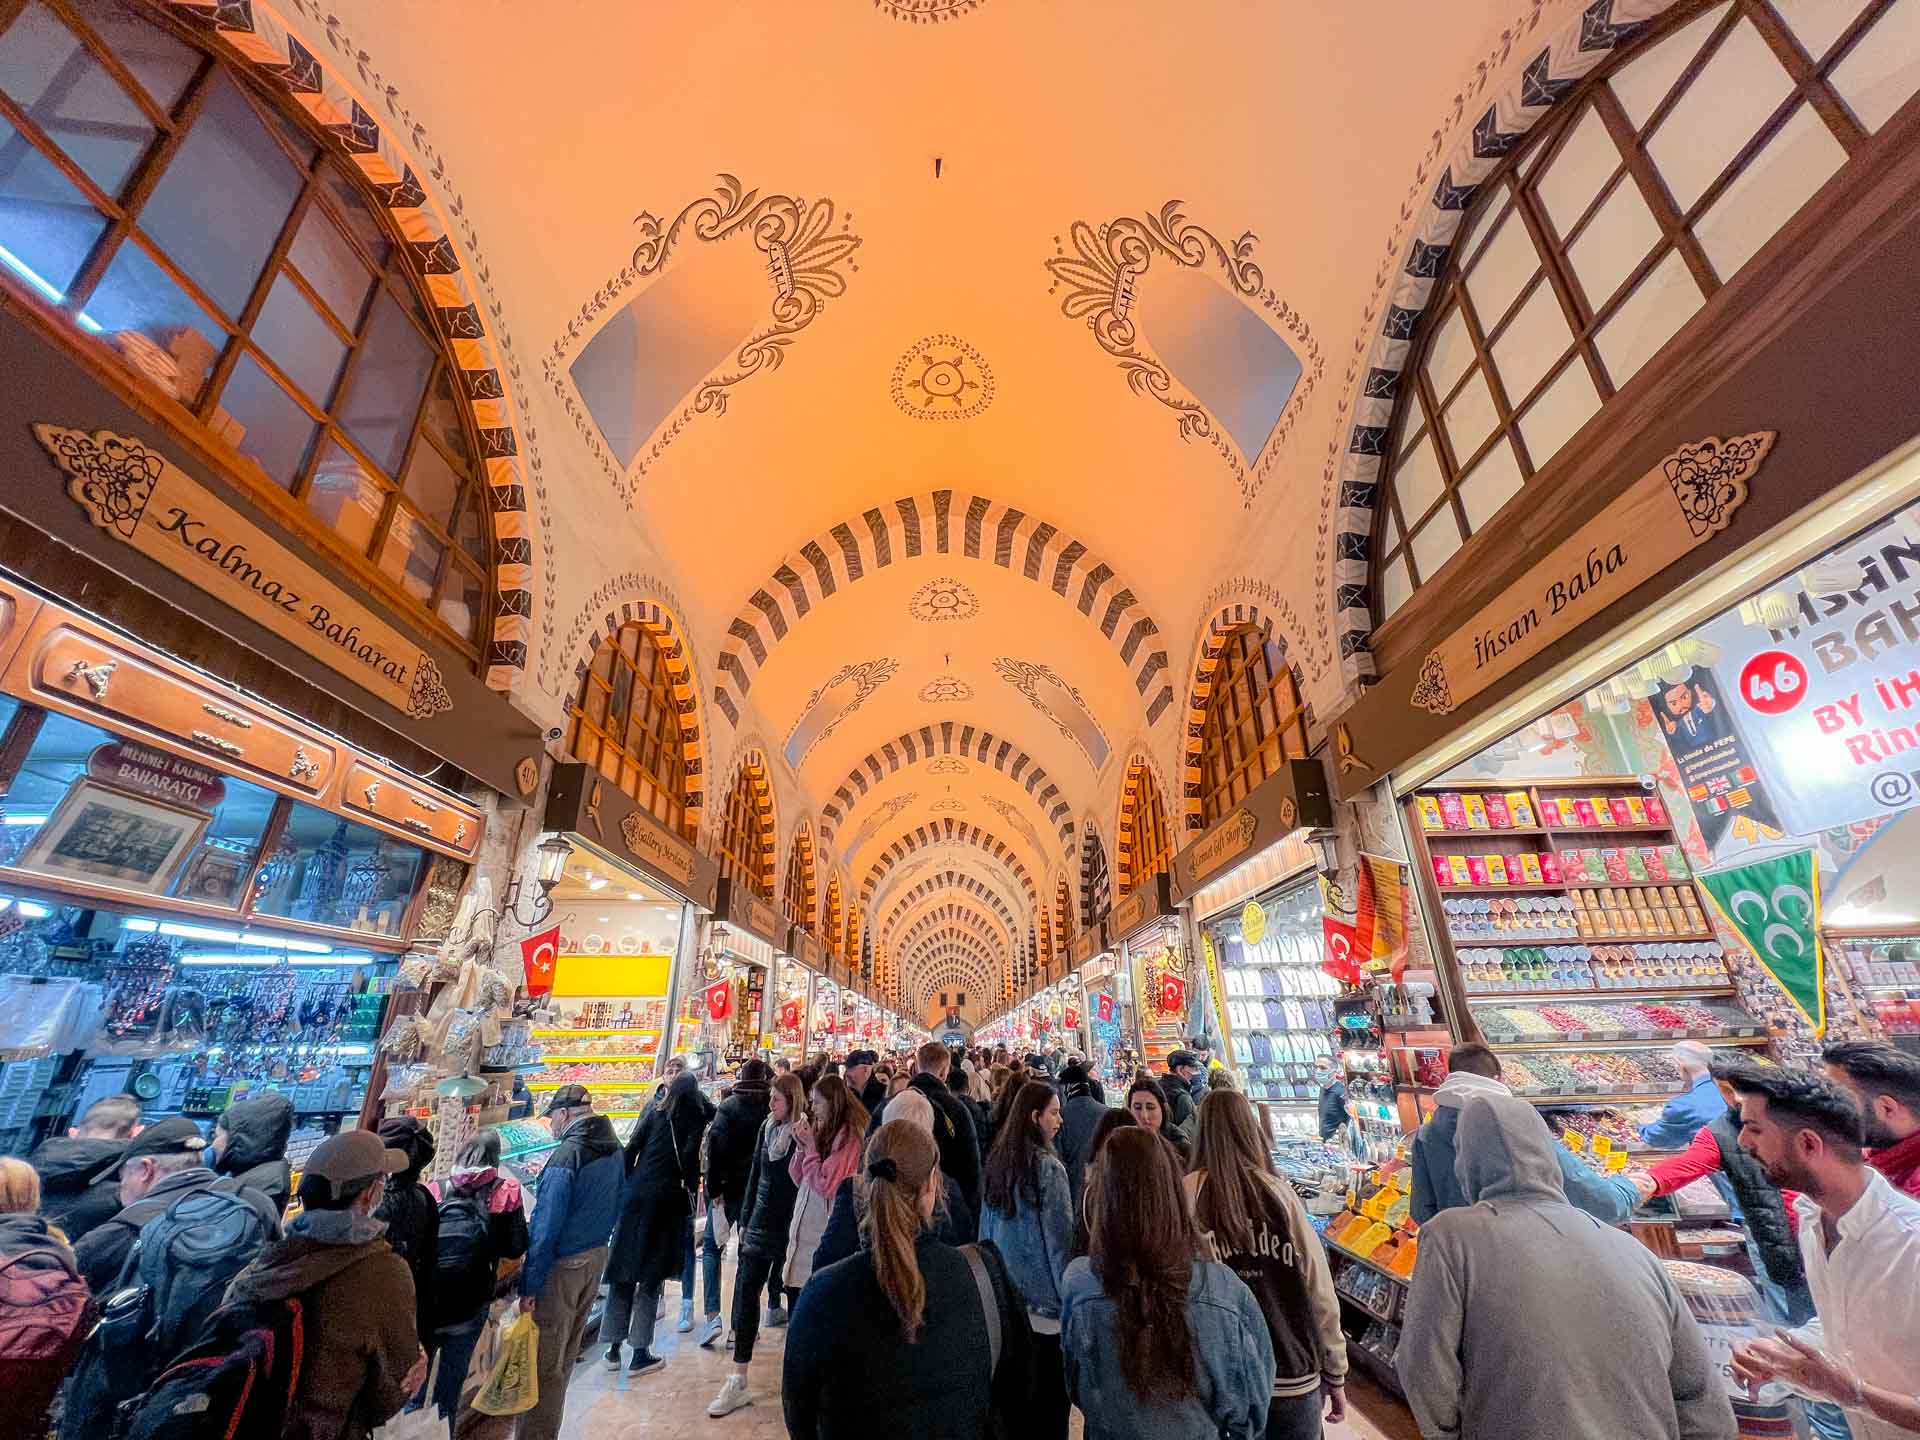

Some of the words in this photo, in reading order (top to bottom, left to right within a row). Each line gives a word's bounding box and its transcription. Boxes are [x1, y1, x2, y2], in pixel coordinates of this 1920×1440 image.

[157, 507, 301, 612] Kalmaz
[307, 604, 408, 684] Baharat
[1545, 544, 1628, 615] Baba
[1750, 661, 1801, 702] 46
[1813, 692, 1864, 735] BY
[119, 743, 170, 770] MEHMET
[171, 761, 216, 785] KALMAZ
[1845, 720, 1920, 766] Rin
[117, 763, 203, 801] BAHARATÇI
[1421, 1056, 1442, 1066] TEA
